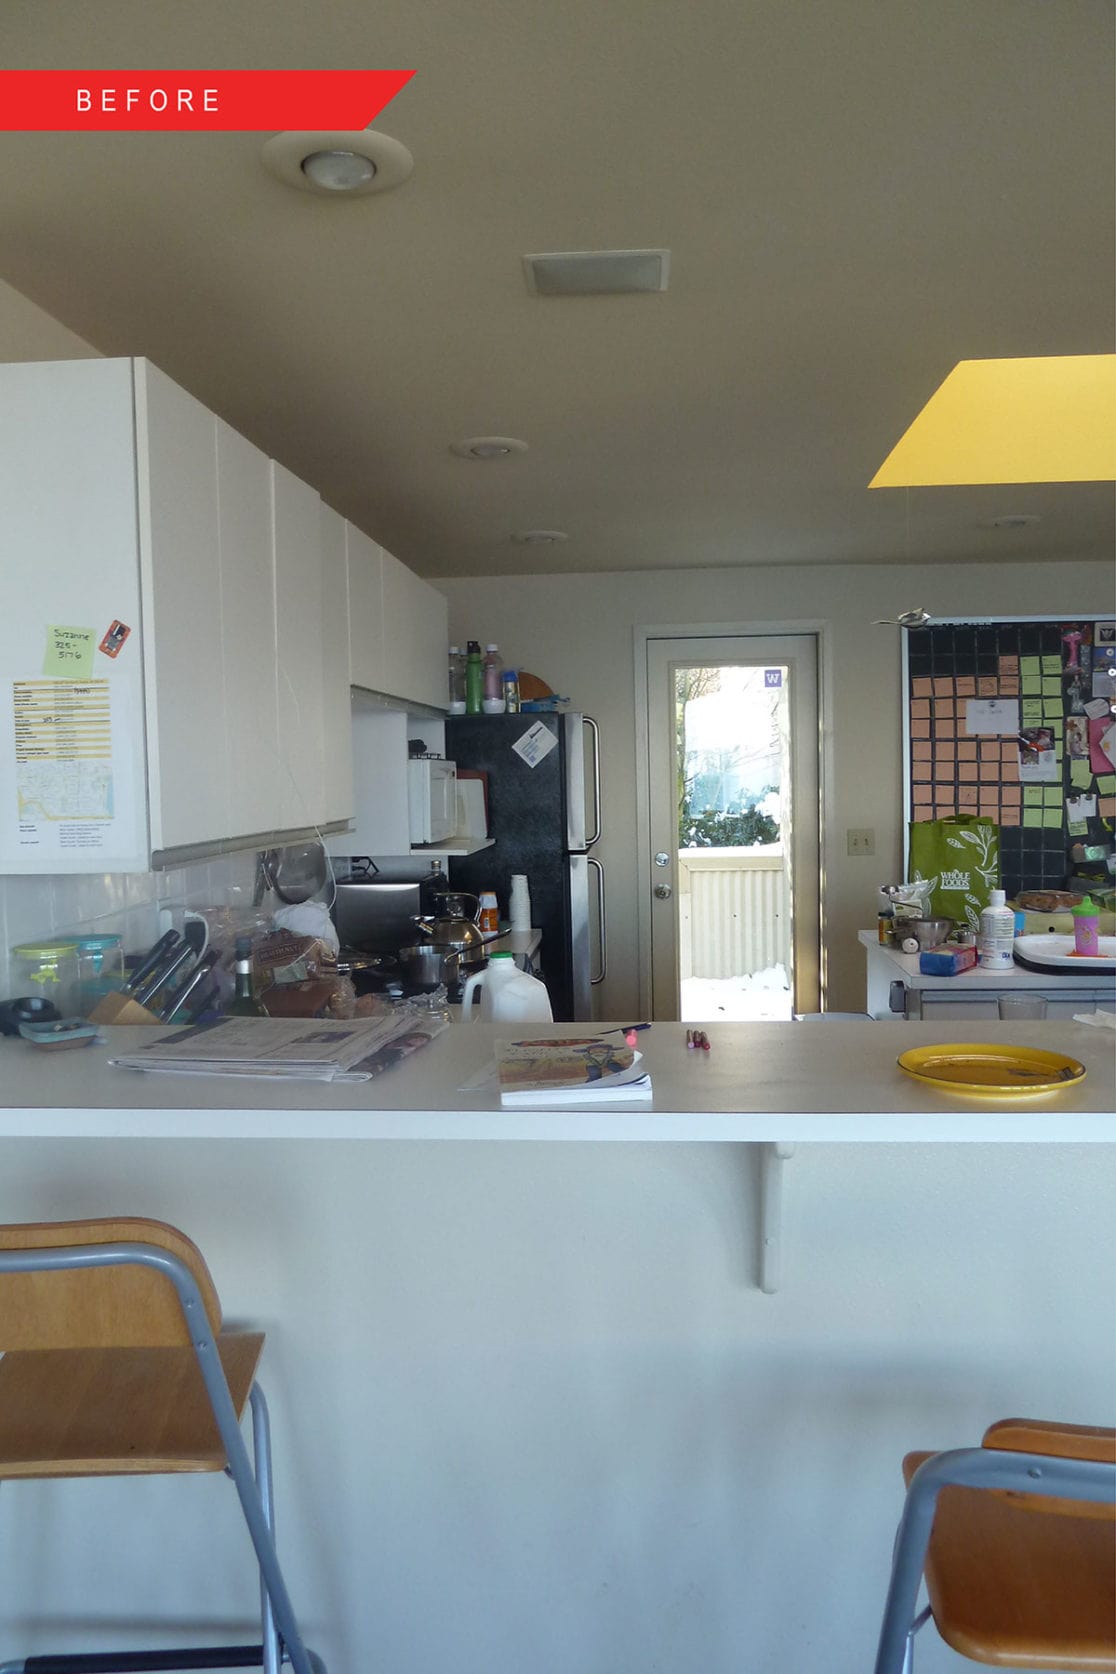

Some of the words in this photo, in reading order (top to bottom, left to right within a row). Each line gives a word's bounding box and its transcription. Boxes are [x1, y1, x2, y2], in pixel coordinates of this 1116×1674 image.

[766, 673, 780, 684] W
[940, 869, 970, 879] WHOLE
[941, 879, 969, 887] FOODS
